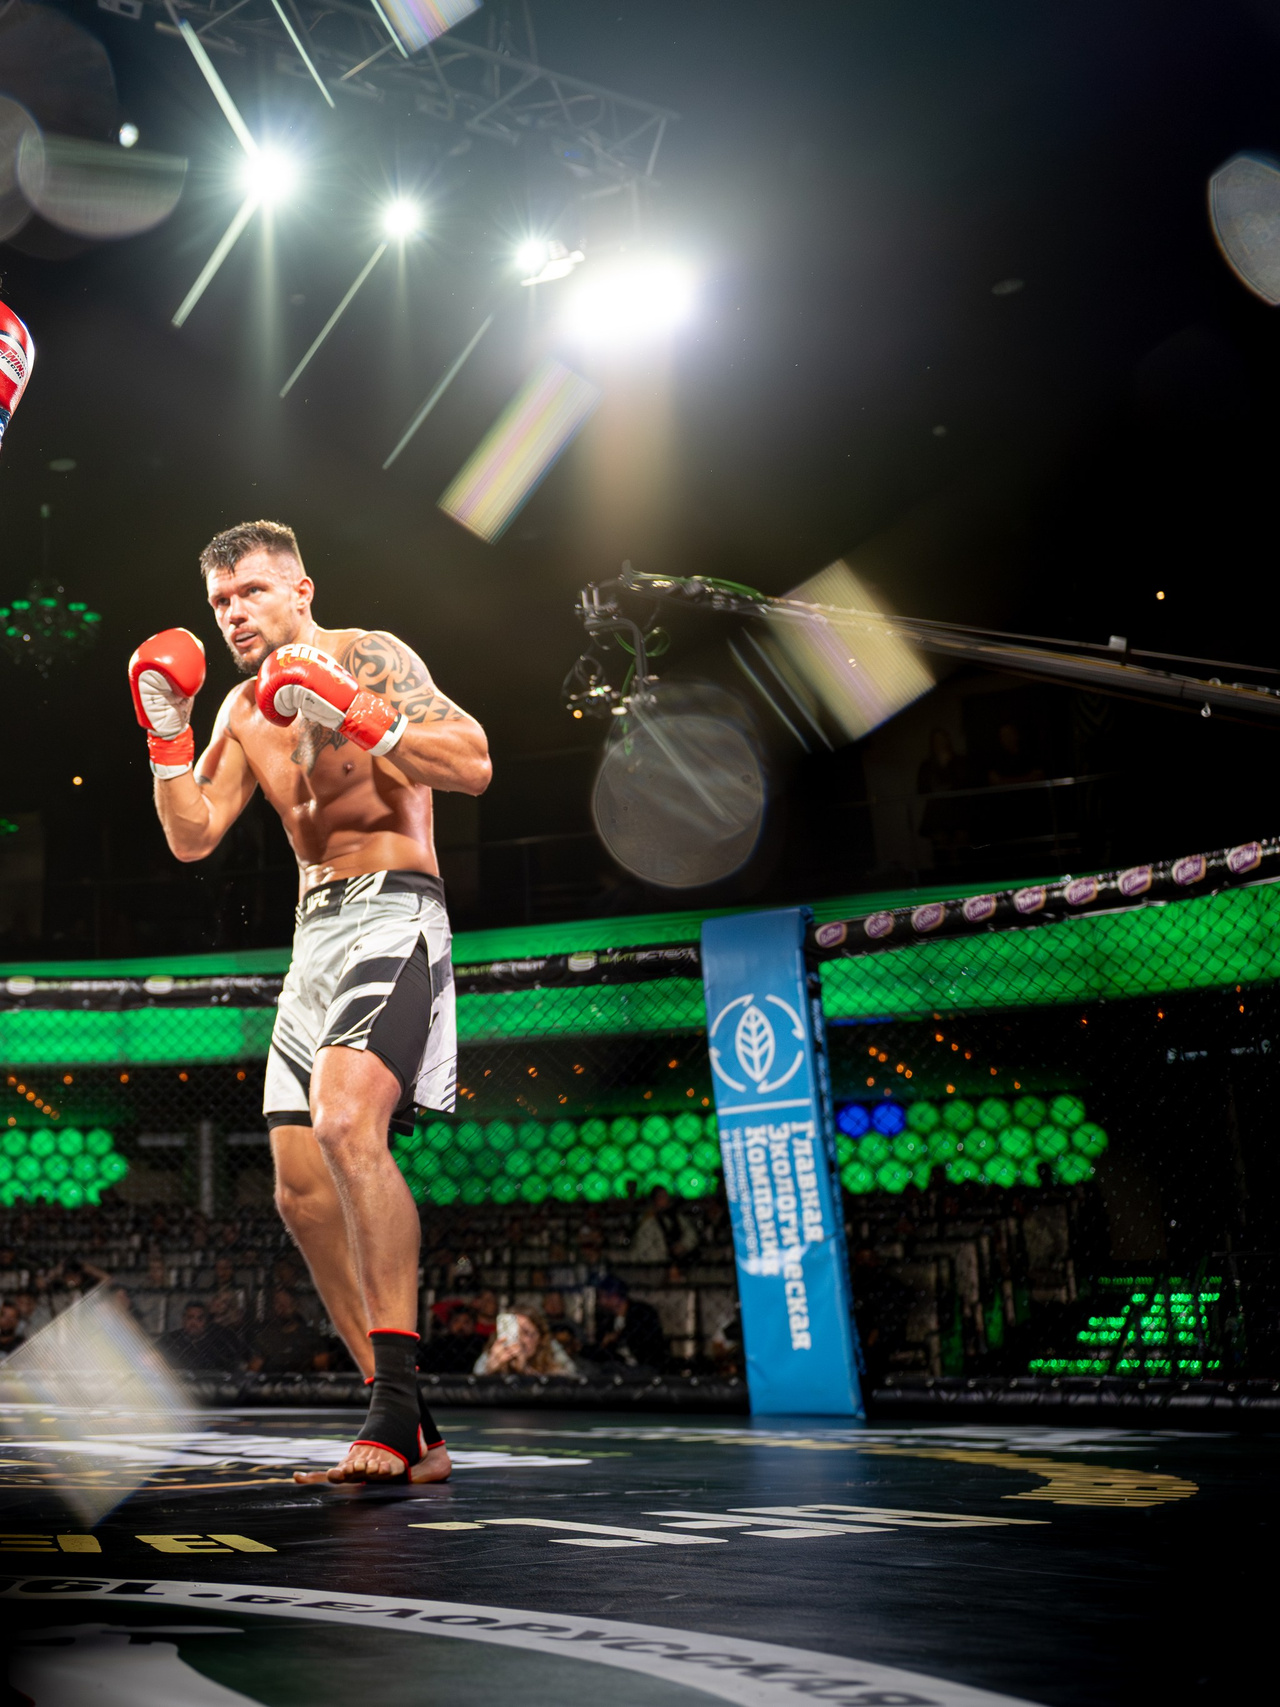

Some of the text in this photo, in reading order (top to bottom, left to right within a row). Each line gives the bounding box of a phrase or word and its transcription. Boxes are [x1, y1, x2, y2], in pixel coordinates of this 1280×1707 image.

[306, 888, 331, 914] UFC
[745, 1124, 780, 1277] Компания
[768, 1123, 812, 1351] Экологическая
[791, 1120, 825, 1243] Главная
[223, 1593, 945, 1707] БЕЛОРУССКАЯ
